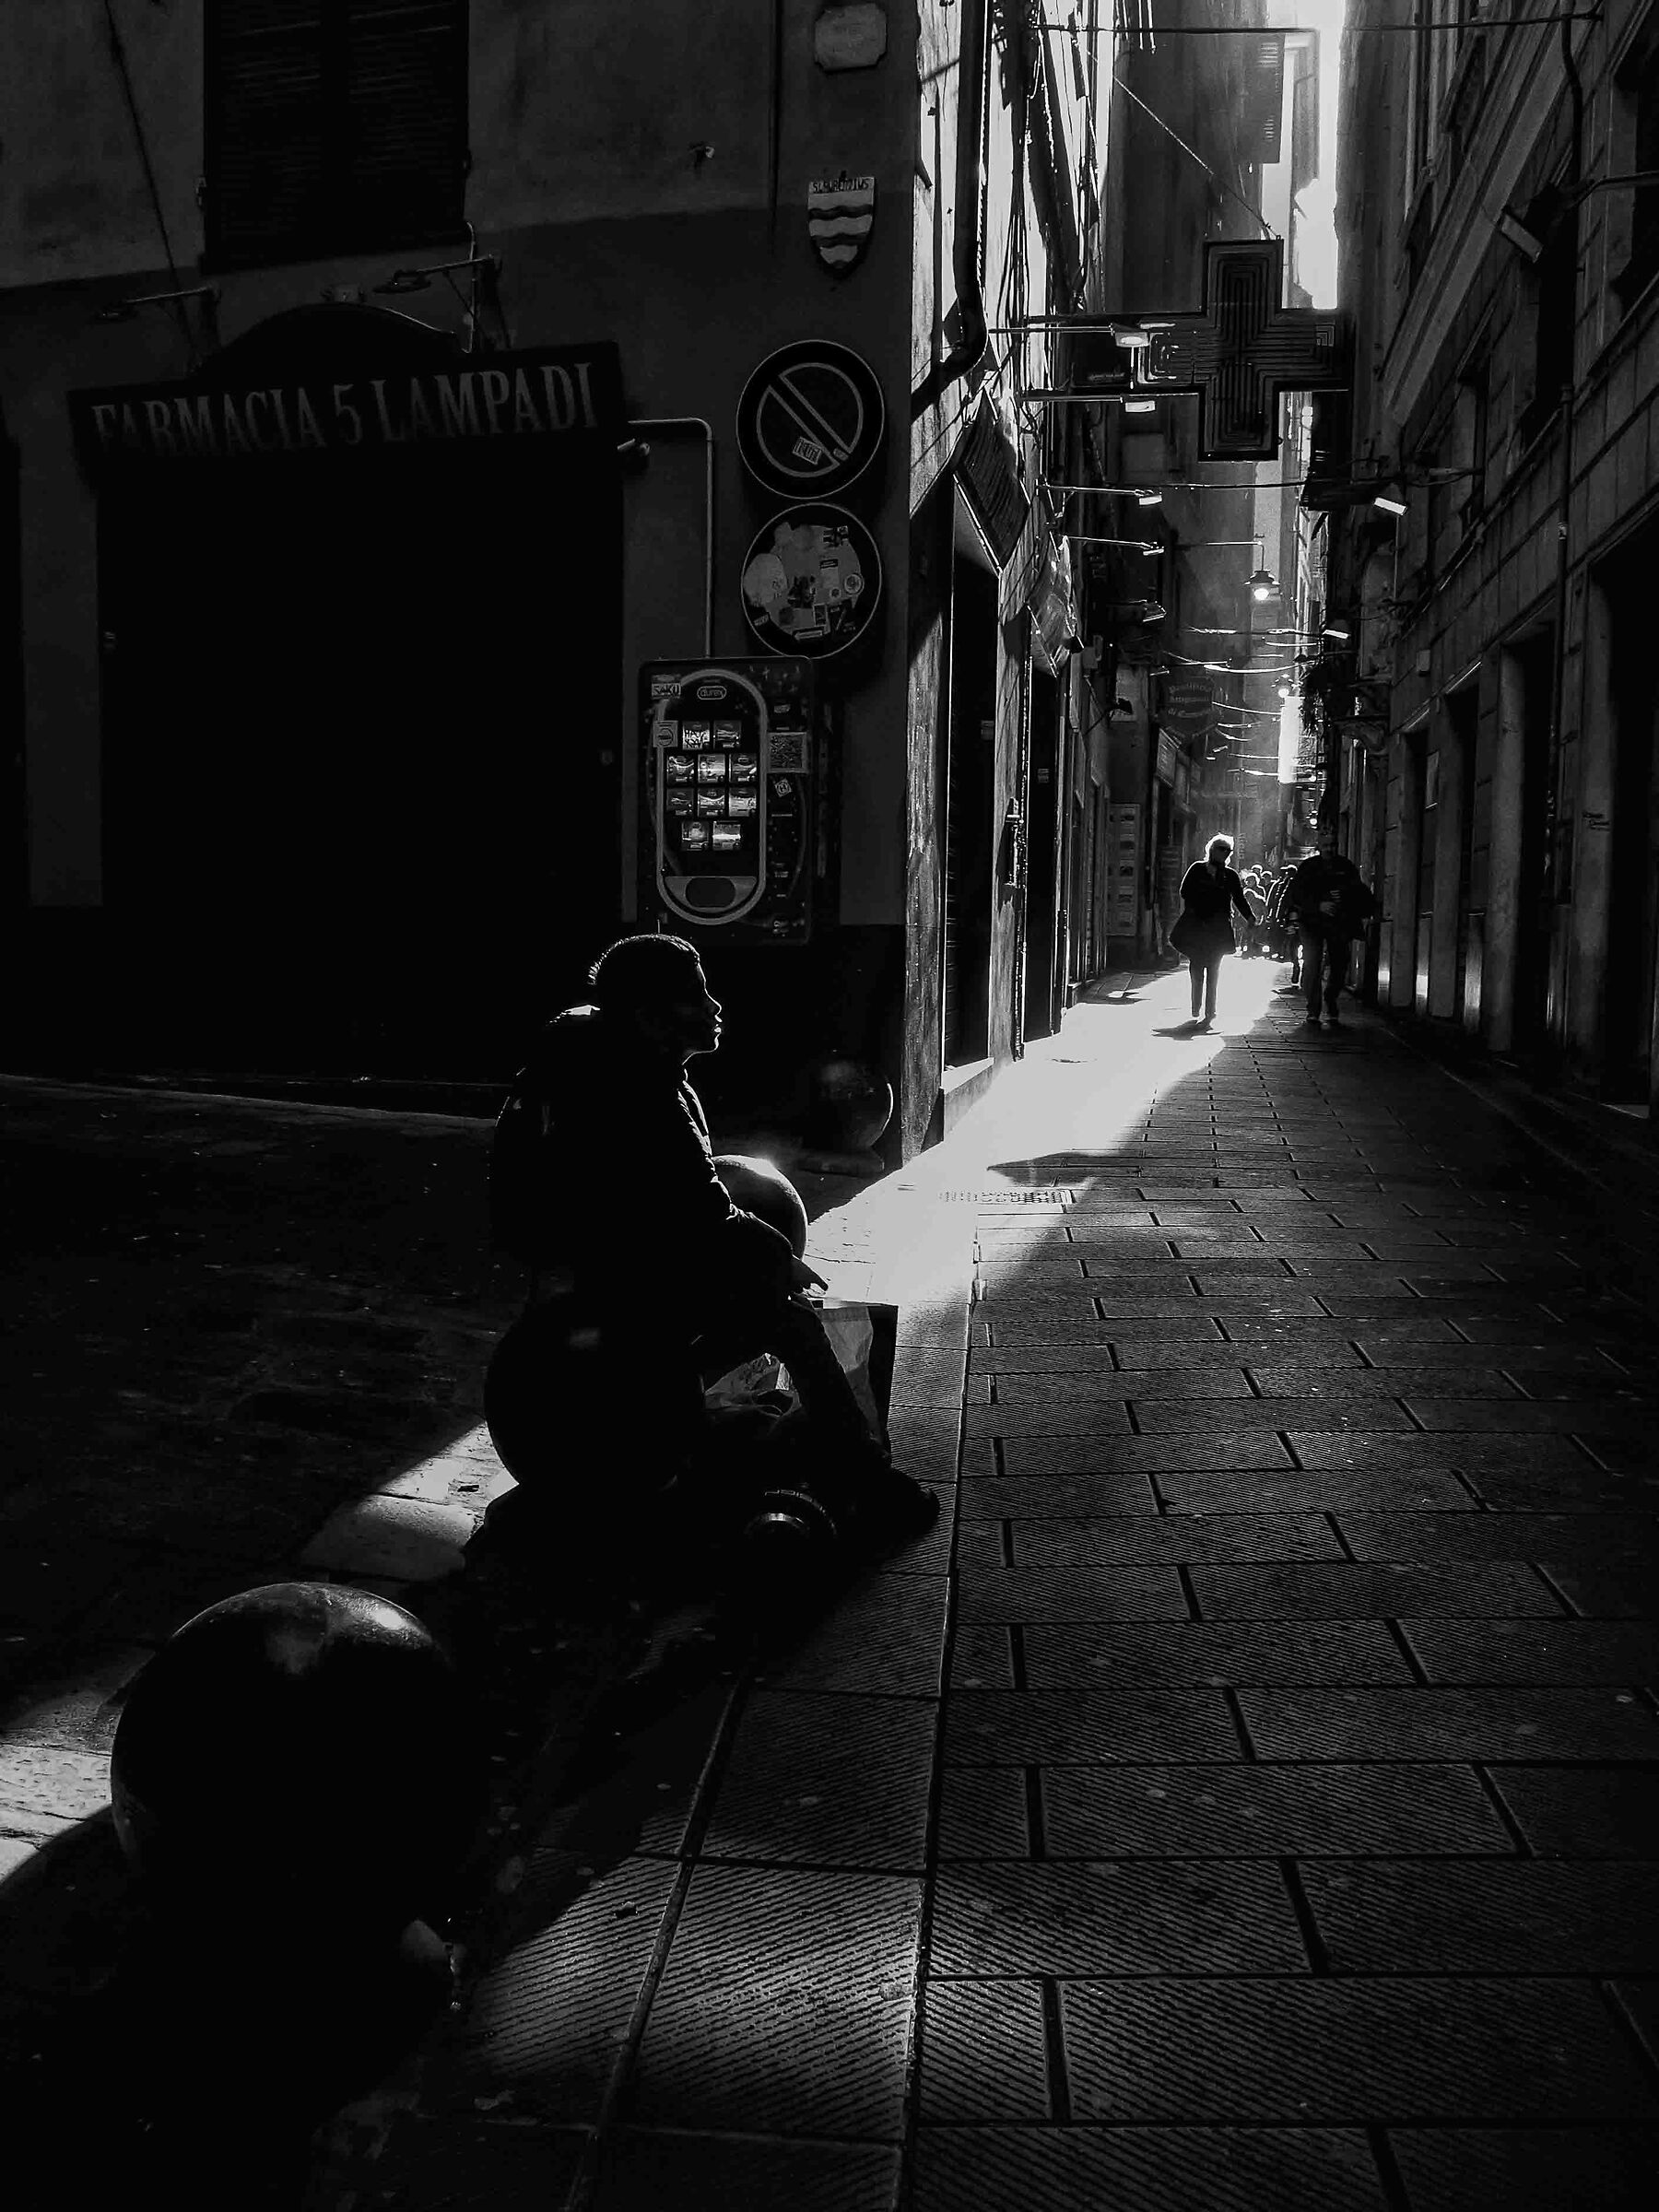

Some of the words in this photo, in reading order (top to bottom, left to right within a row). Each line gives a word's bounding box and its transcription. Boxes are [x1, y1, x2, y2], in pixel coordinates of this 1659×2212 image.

[90, 385, 328, 457] FARMACIA
[332, 382, 363, 446] 5
[370, 360, 599, 443] LAMPADI
